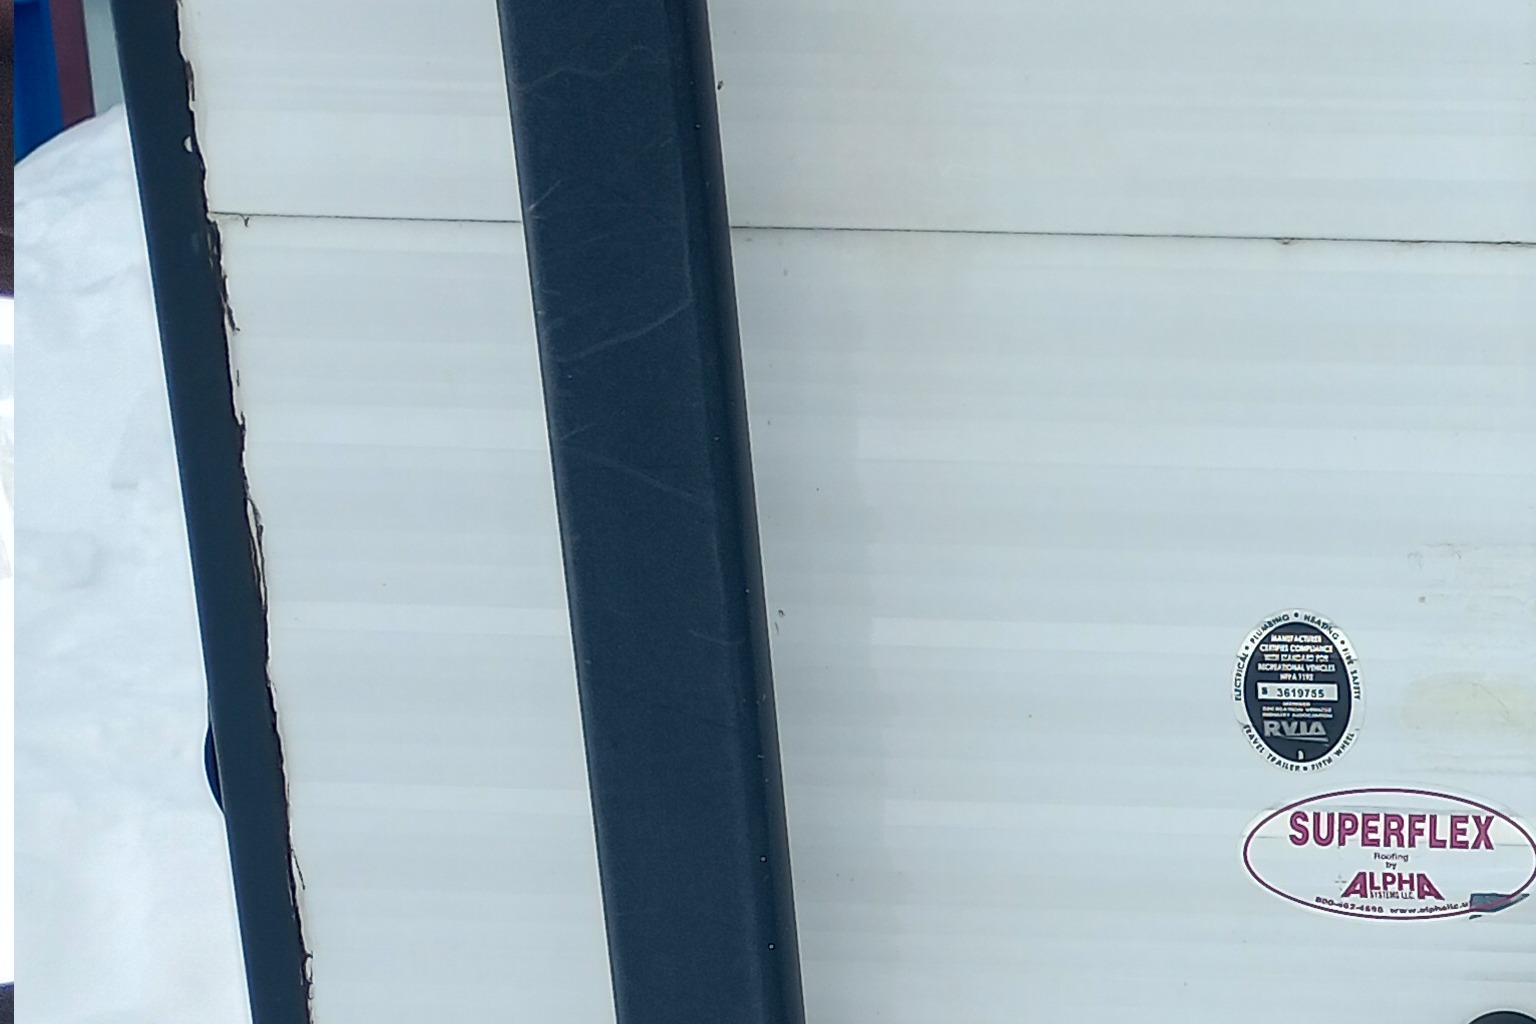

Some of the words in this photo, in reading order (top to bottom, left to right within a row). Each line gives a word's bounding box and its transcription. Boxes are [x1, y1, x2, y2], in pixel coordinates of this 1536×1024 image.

[1276, 688, 1325, 698] 3619755
[1263, 720, 1327, 737] RVIA
[1289, 811, 1495, 850] SUPERFLEX
[1373, 852, 1409, 862] Roofing
[1385, 861, 1397, 870] by
[1341, 871, 1445, 900] ALPHA
